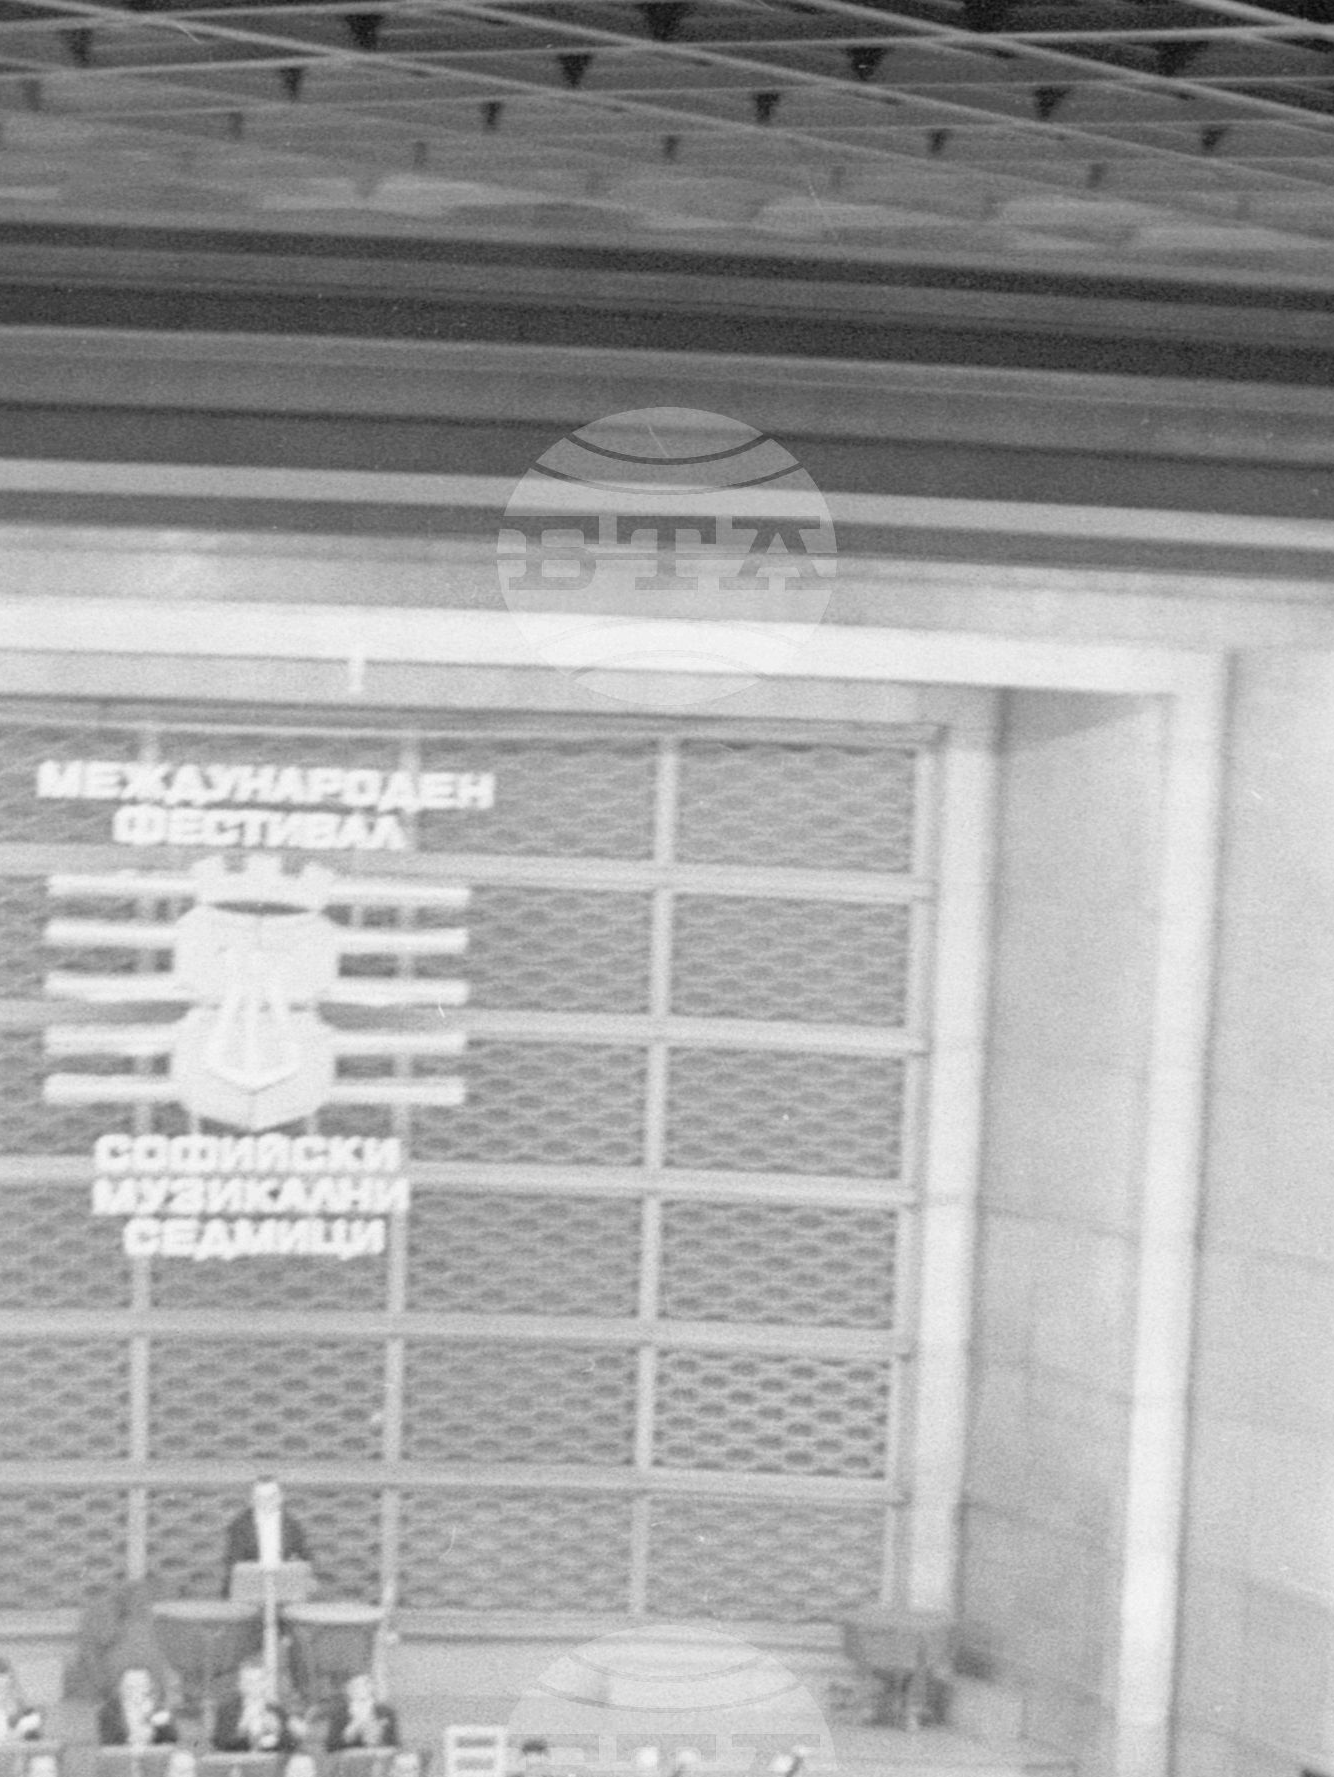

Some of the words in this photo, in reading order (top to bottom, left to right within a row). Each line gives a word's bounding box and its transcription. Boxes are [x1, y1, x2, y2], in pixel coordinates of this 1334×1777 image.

[36, 760, 496, 812] МЕЖДУНАРОДЕН
[112, 804, 409, 850] ФЕСТИВАЛ
[93, 1132, 403, 1173] СОФИЙСКИ
[91, 1176, 411, 1216] МУЗИКАЛНИ
[122, 1217, 387, 1261] СЕДМИЦИ
